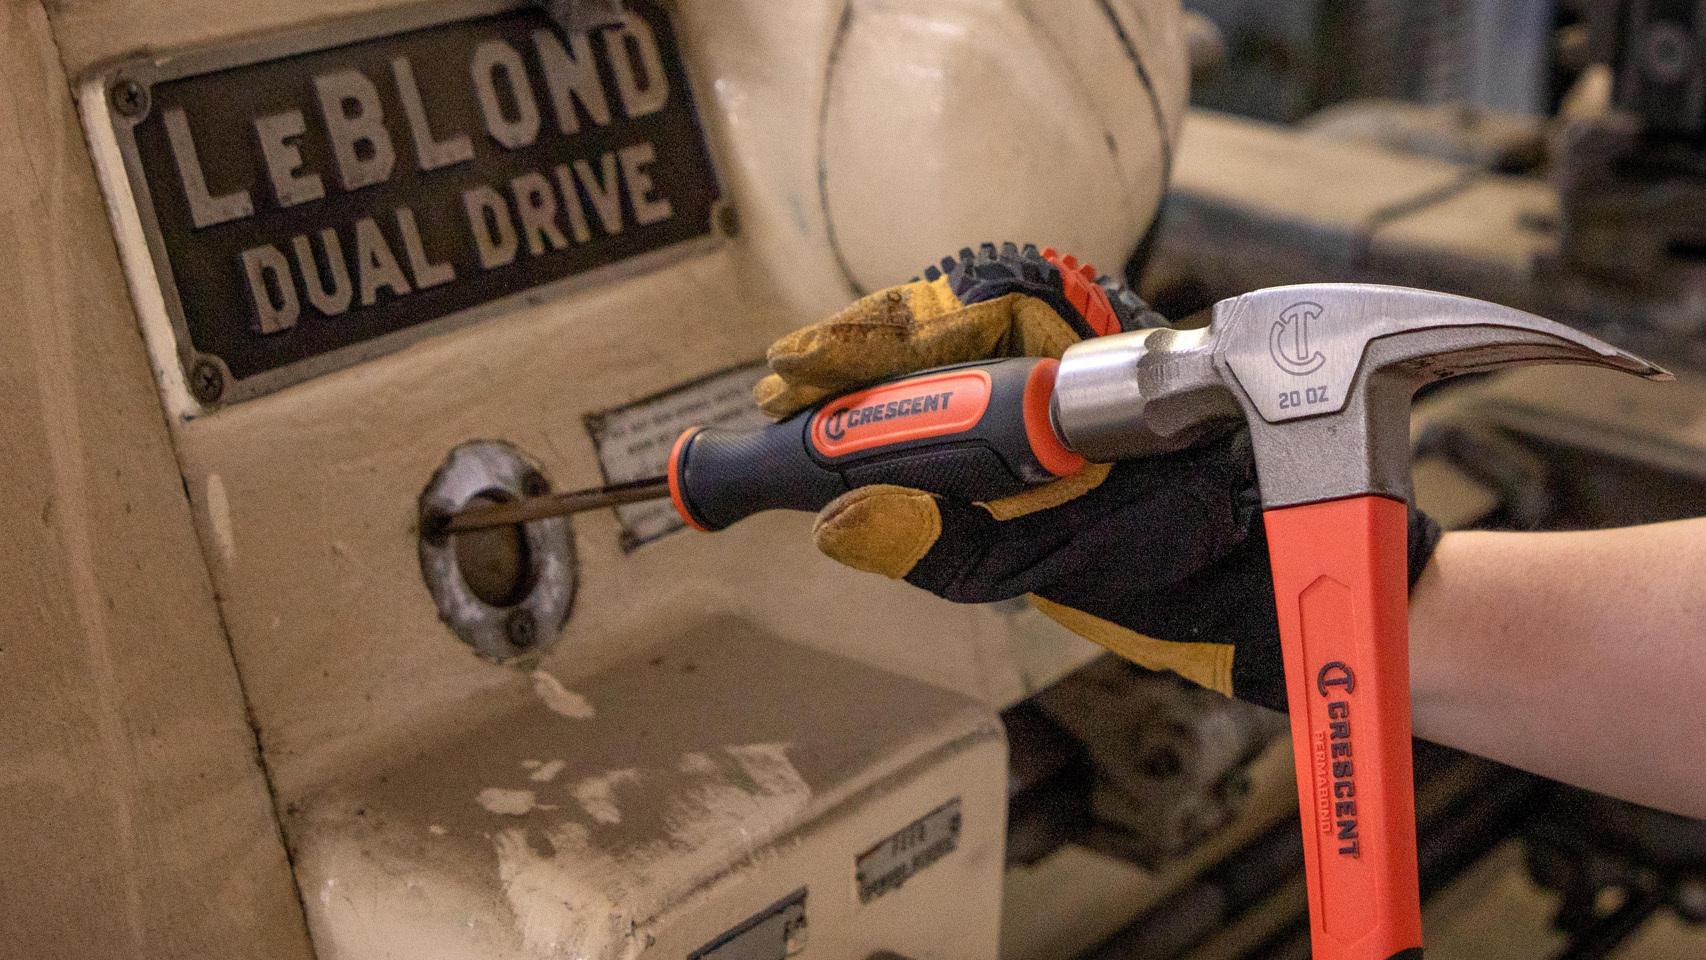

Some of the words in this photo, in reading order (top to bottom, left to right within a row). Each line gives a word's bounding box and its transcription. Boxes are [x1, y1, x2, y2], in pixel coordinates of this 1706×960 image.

[241, 207, 456, 335] DUAL
[464, 143, 672, 270] DRIVE
[847, 392, 954, 428] CRESCENT
[1279, 390, 1301, 409] 20
[1305, 386, 1329, 405] OZ
[1314, 730, 1332, 834] PERMABOND
[1327, 701, 1360, 859] CRESCENT
